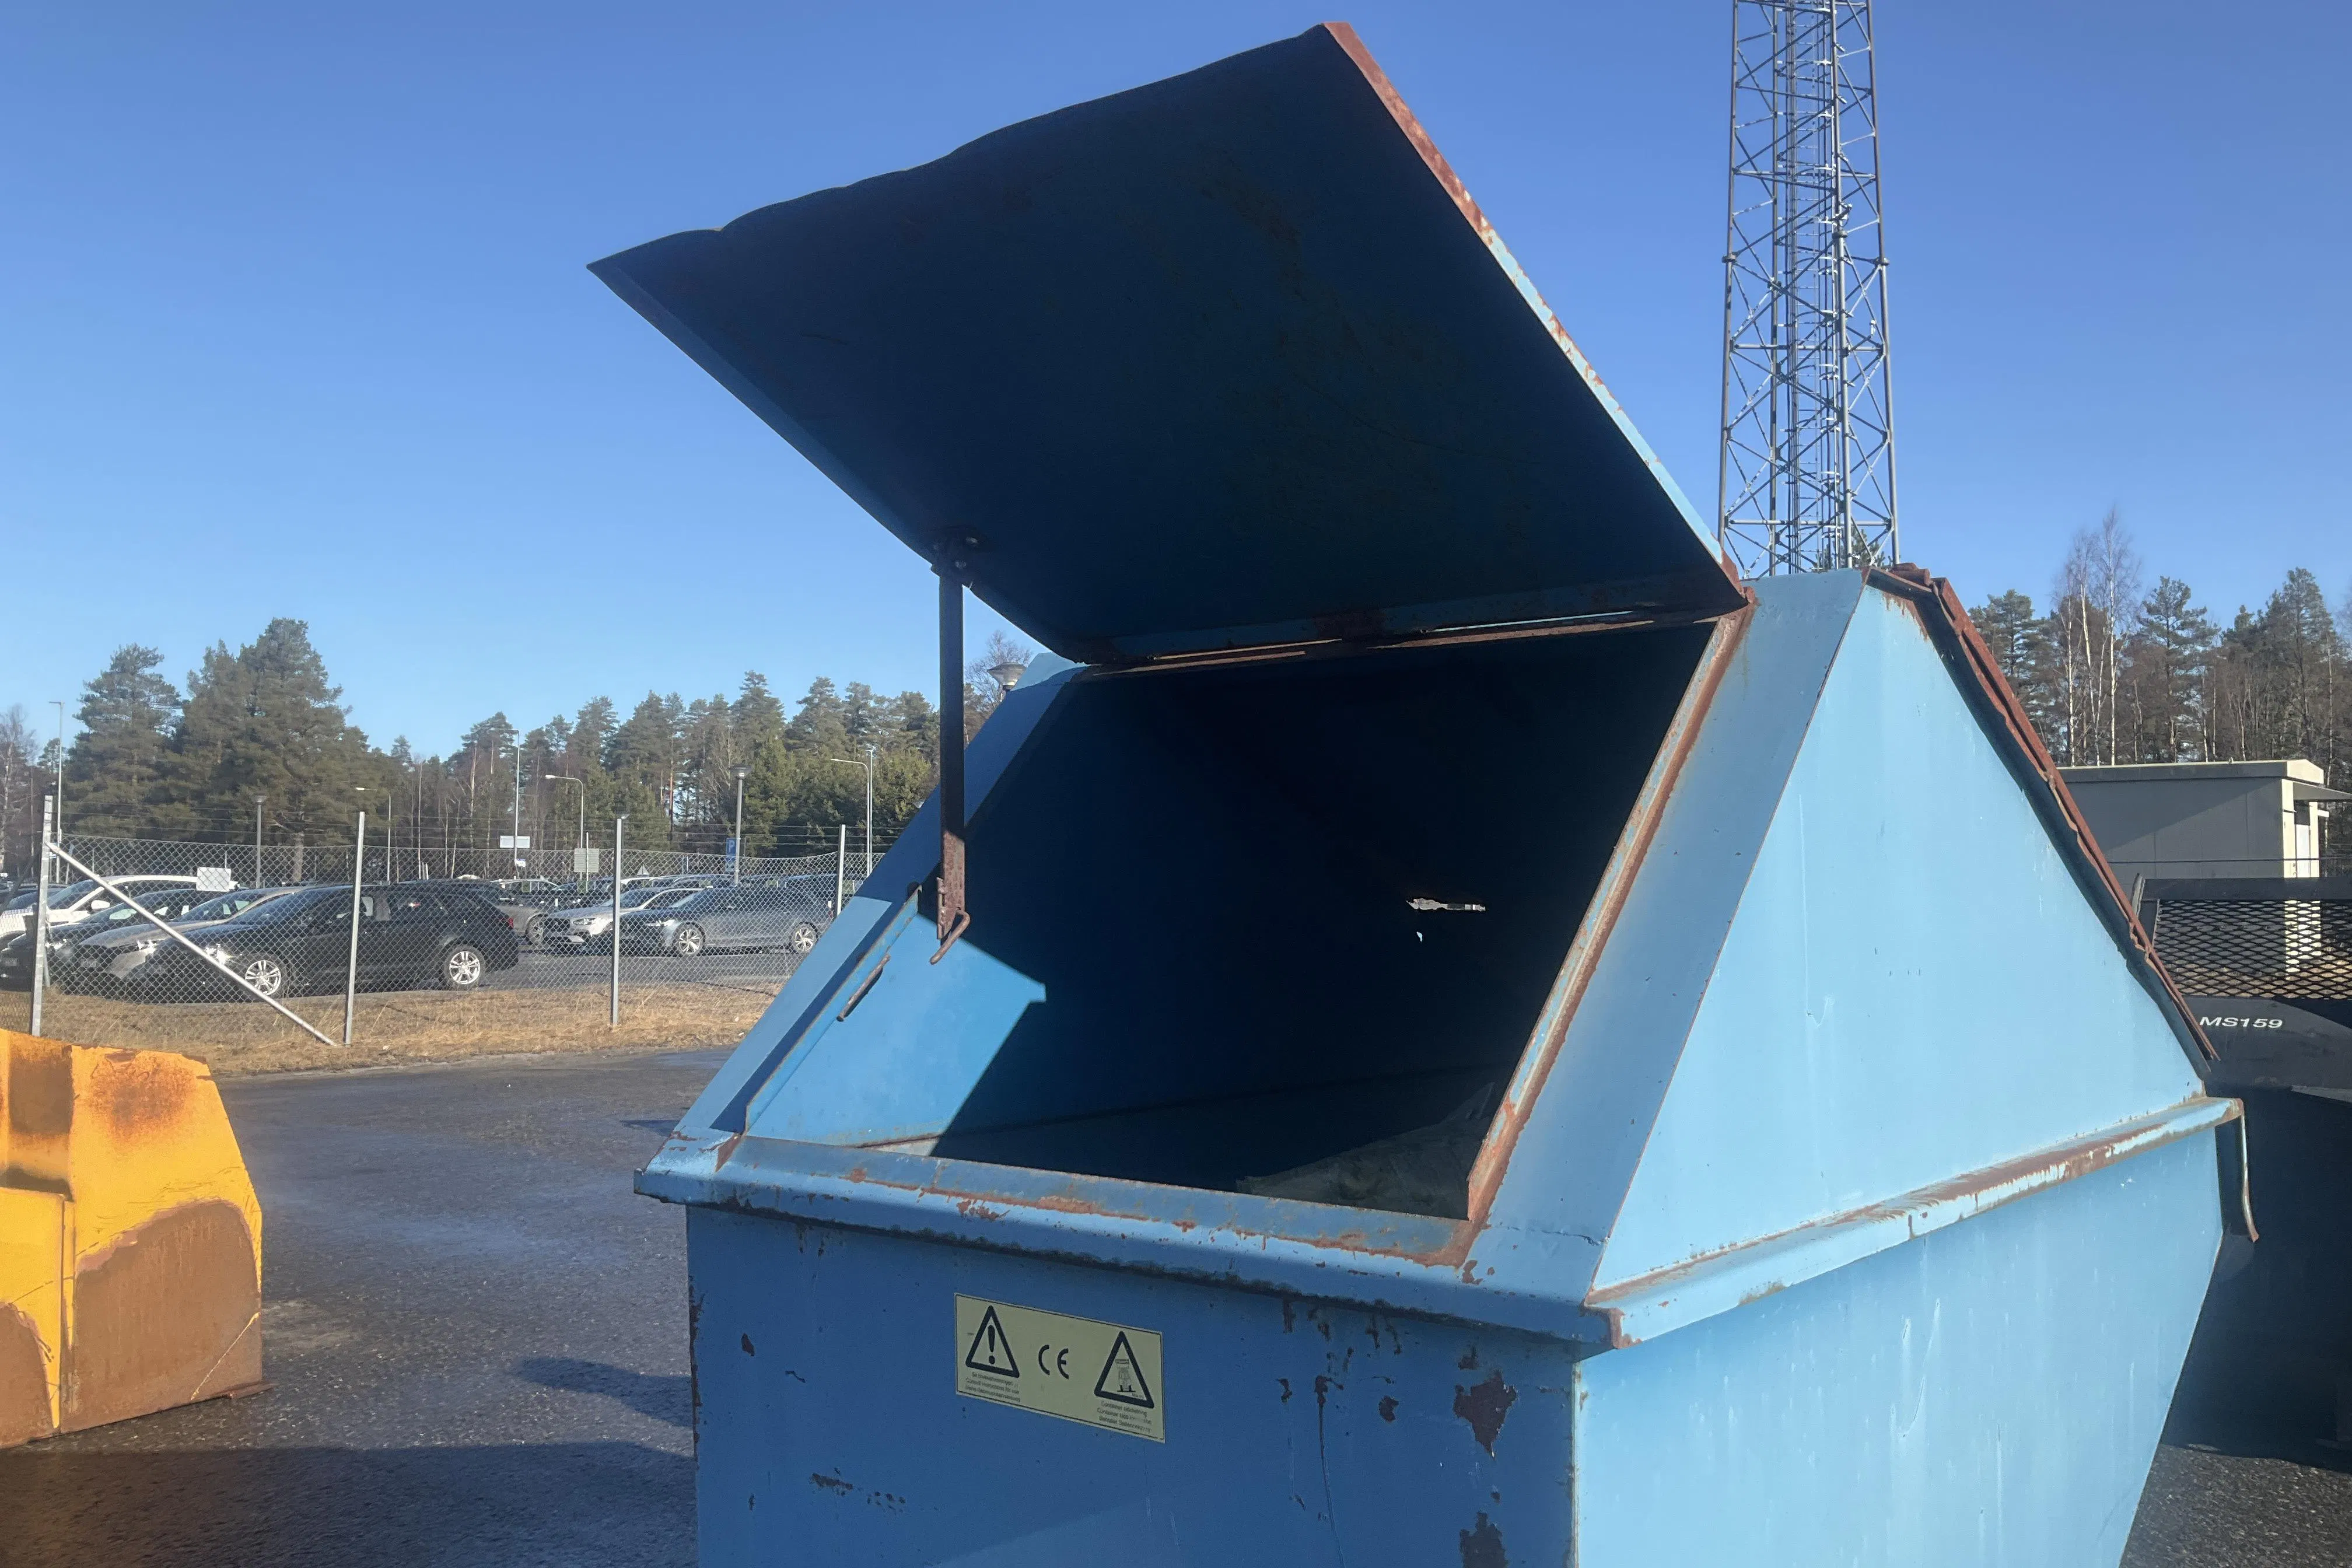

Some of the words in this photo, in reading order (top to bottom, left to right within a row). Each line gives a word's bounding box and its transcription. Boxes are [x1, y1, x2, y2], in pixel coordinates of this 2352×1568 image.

[729, 839, 735, 853] P
[2199, 1016, 2283, 1028] MS159
[1038, 1344, 1069, 1380] CE
